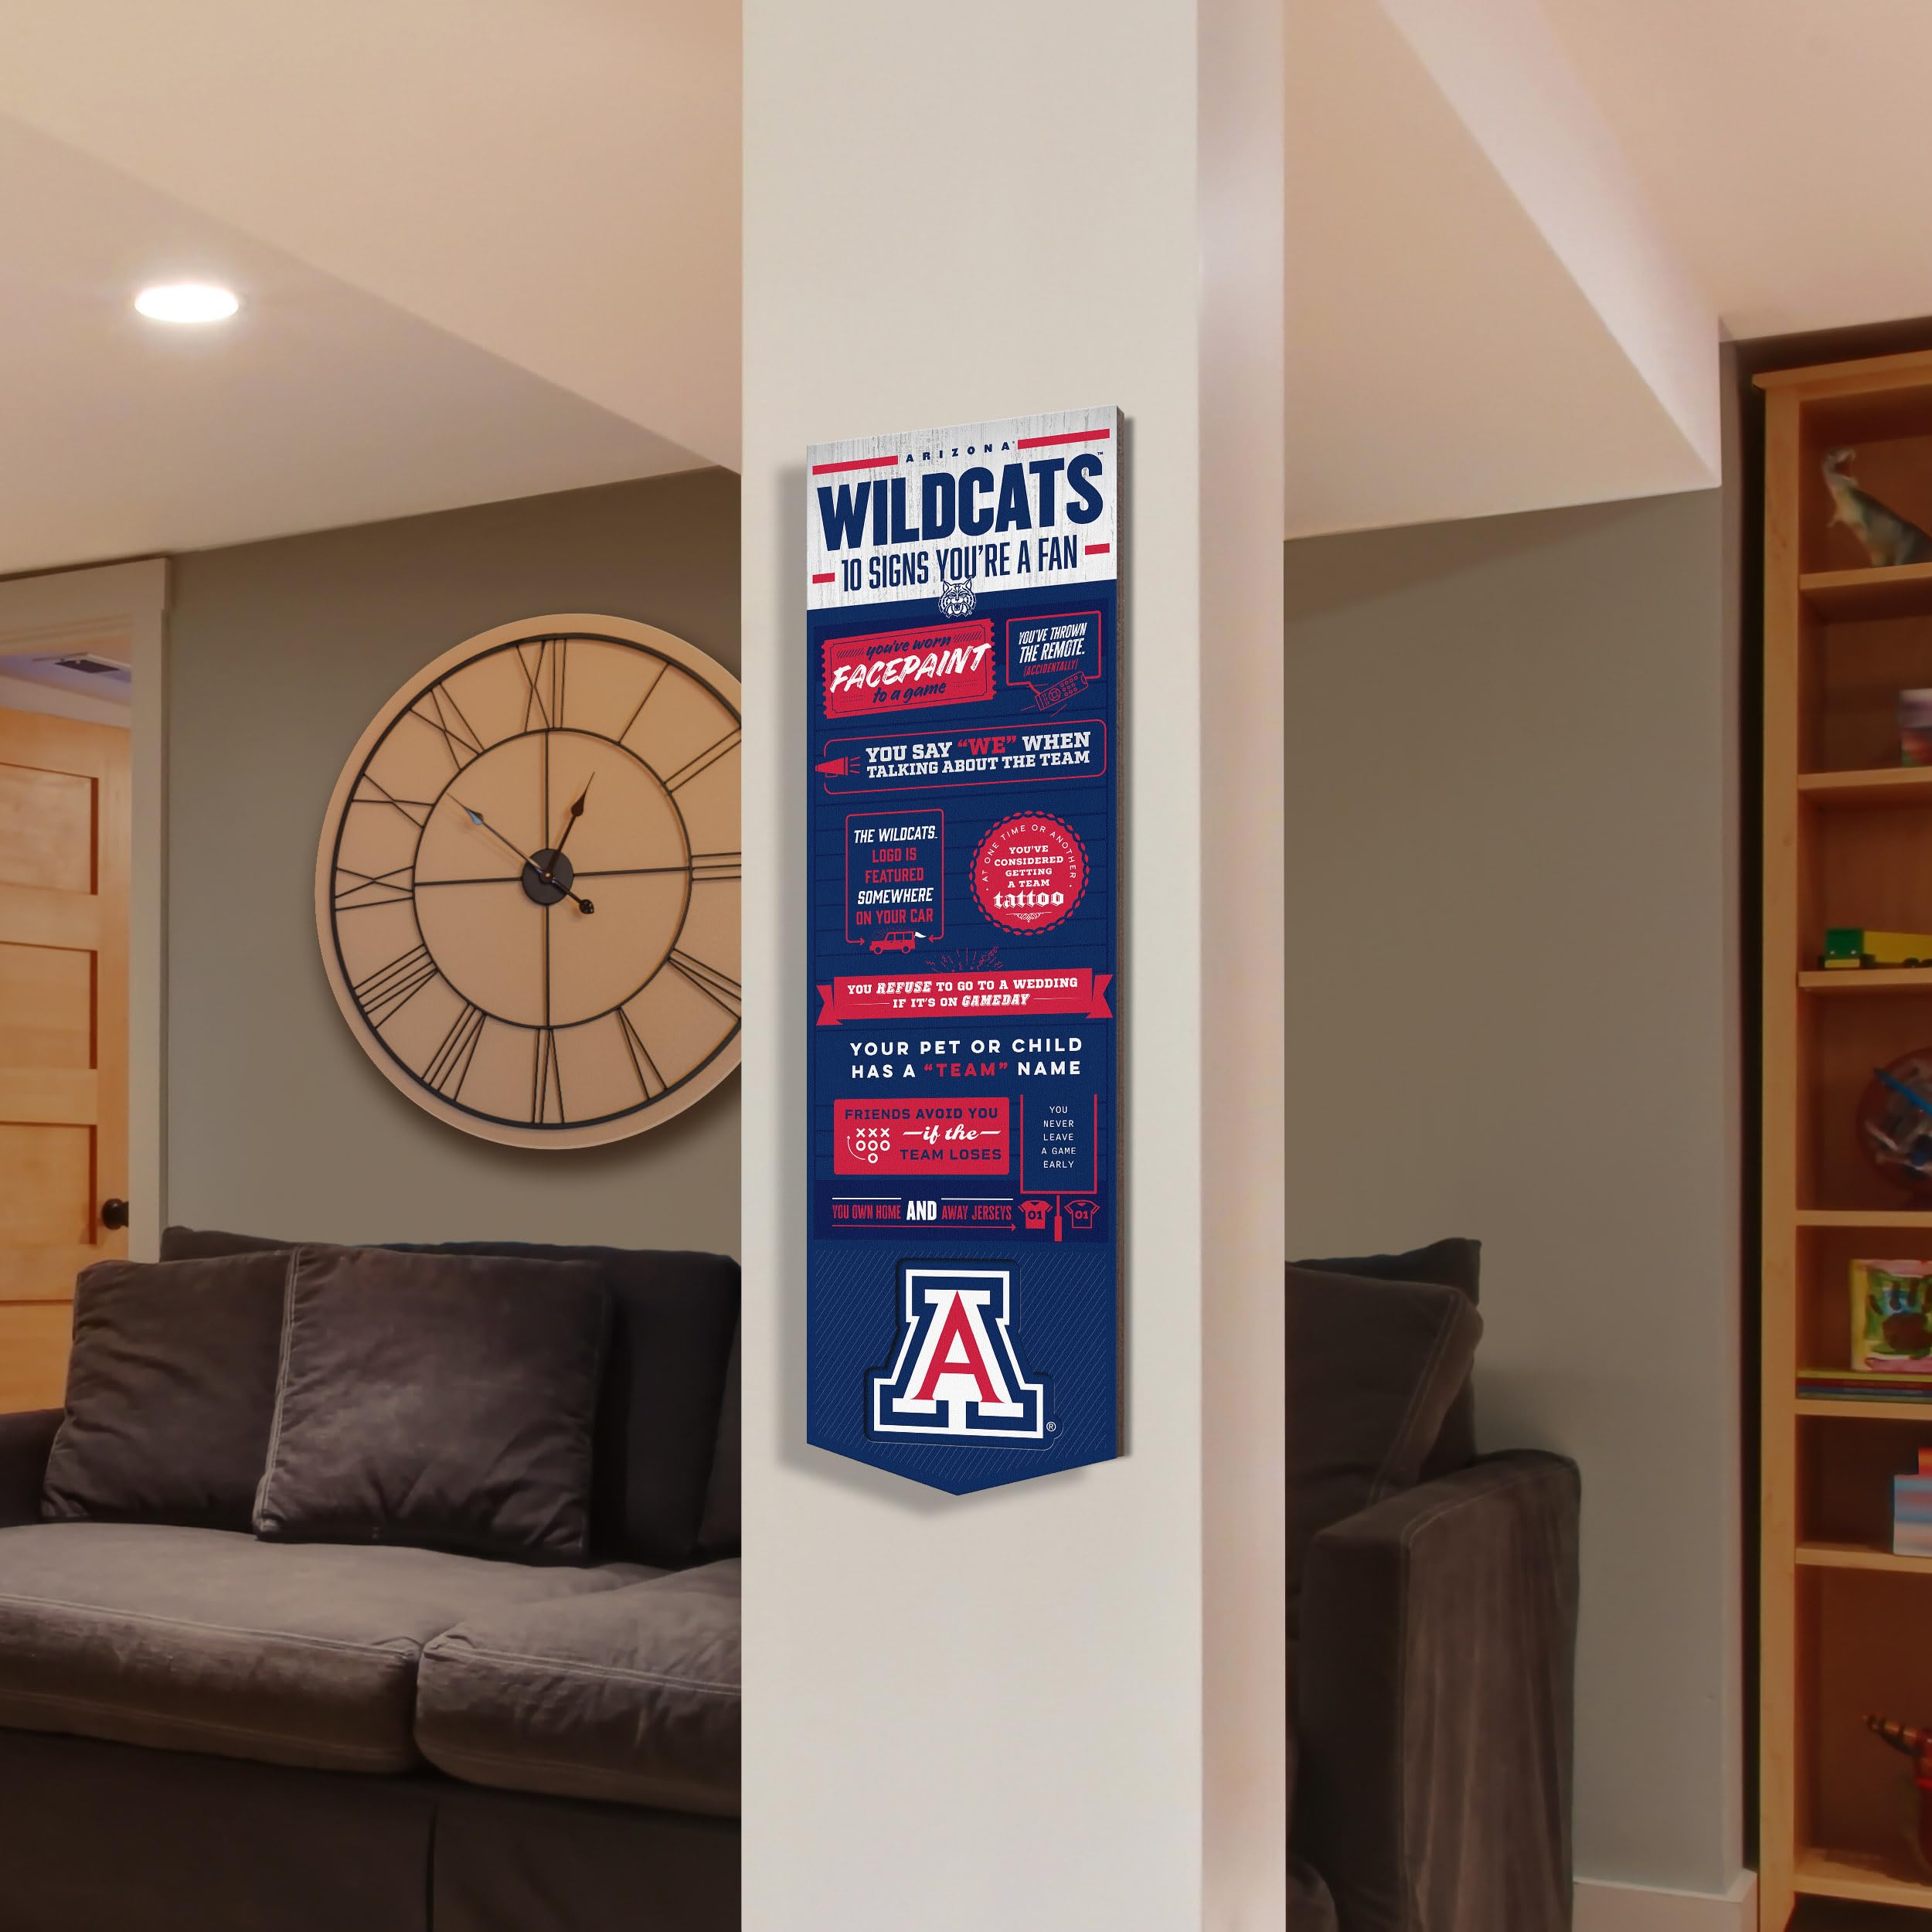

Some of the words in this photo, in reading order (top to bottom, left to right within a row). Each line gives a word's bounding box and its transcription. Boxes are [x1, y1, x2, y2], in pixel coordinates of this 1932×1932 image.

[906, 442, 1010, 463] ARIZONA
[817, 453, 1104, 552] WILDCATS
[841, 558, 862, 592] 10
[869, 551, 928, 590] SIGNS
[936, 542, 1010, 582] YOU'RE
[1017, 539, 1032, 574] A
[1038, 535, 1077, 572] FAN
[1019, 628, 1048, 645] YOU'VE
[1049, 622, 1087, 641] THROWN
[866, 639, 909, 661] you've
[913, 636, 951, 651] worn
[1019, 644, 1039, 664] THE
[1040, 638, 1085, 661] REMOTE.
[830, 643, 992, 693] FACEPAINT
[1023, 658, 1079, 678] (ACCIDENTALLY)
[872, 686, 888, 704] to
[889, 690, 901, 701] a
[902, 682, 947, 704] game
[866, 745, 907, 763] YOU
[912, 741, 953, 760] SAY
[957, 735, 1016, 755] “WE”
[1022, 731, 1091, 751] WHEN
[866, 761, 938, 778] TALKING
[941, 757, 998, 774] ABOUT
[1002, 753, 1036, 770] THE
[1039, 750, 1090, 767] TEAM
[854, 828, 876, 844] THE
[1000, 825, 1026, 841] TIME
[1031, 824, 1046, 832] OR
[872, 848, 902, 863] LOGO
[905, 847, 917, 862] IS
[984, 842, 1000, 864] ONE
[1009, 845, 1049, 855] YOU'VE
[1049, 831, 1077, 879] ANOTHER
[994, 855, 1064, 867] CONSIDERED
[865, 867, 924, 884] FEATURED
[981, 869, 988, 883] AT
[1005, 868, 1053, 877] GETTING
[1019, 879, 1050, 887] TEAM
[857, 887, 934, 905] SOMEWHERE
[993, 889, 1064, 910] tattoo
[855, 910, 872, 925] ON
[876, 909, 907, 925] YOUR
[910, 908, 934, 923] CAR
[847, 984, 872, 995] YOU
[876, 981, 933, 995] REFUSE
[936, 981, 953, 992] TO
[957, 980, 972, 992] GO
[978, 979, 995, 991] TO
[998, 979, 1009, 990] A
[1012, 977, 1078, 989] WEDDING
[893, 998, 906, 1009] IF
[910, 997, 936, 1009] IT'S
[940, 995, 958, 1007] ON
[961, 993, 1031, 1008] GAMEDAY
[850, 1041, 910, 1056] YOUR
[920, 1039, 961, 1055] PET
[971, 1039, 1001, 1054] OR
[1012, 1037, 1082, 1053] CHILD
[851, 1063, 894, 1079] HAS
[903, 1063, 916, 1078] A
[923, 1062, 1009, 1077] “TEAM”
[1018, 1060, 1081, 1076] NAME
[845, 1108, 910, 1120] FRIENDS
[915, 1107, 963, 1119] AVOID
[968, 1107, 998, 1119] YOU
[923, 1125, 941, 1145] if
[944, 1124, 979, 1141] the
[1043, 1133, 1074, 1141] LEAVE
[900, 1149, 944, 1160] TEAM
[950, 1148, 1002, 1160] LOSES
[832, 1204, 849, 1219] YOU
[852, 1204, 873, 1219] OWN
[876, 1205, 901, 1219] HOME
[906, 1200, 937, 1221] AND
[941, 1205, 969, 1220] AWAY
[971, 1205, 1012, 1220] JERSEYS
[1028, 1210, 1043, 1220] 01
[1075, 1210, 1089, 1219] 01
[874, 1269, 1043, 1439] A
